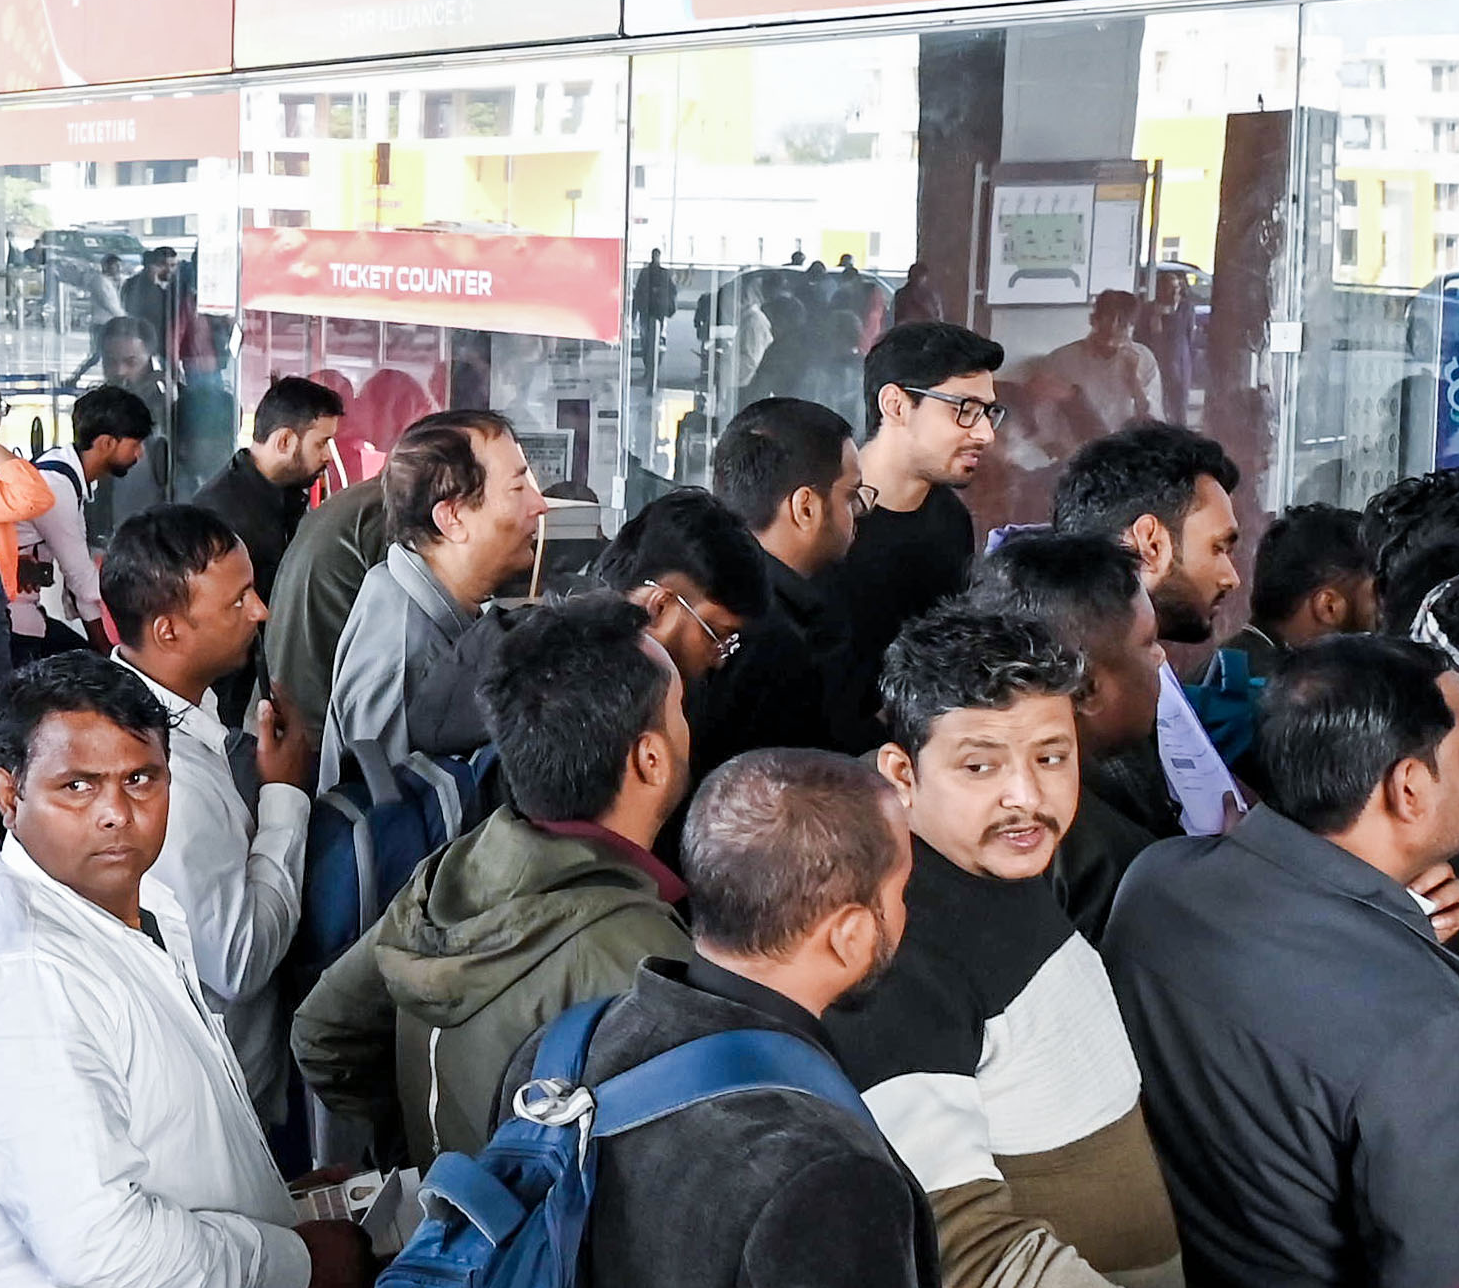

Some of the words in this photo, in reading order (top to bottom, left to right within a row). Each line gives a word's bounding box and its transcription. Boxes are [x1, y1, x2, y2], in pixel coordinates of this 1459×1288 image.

[67, 119, 137, 145] TICKETING
[329, 262, 394, 290] TICKET
[396, 266, 493, 296] COUNTER
